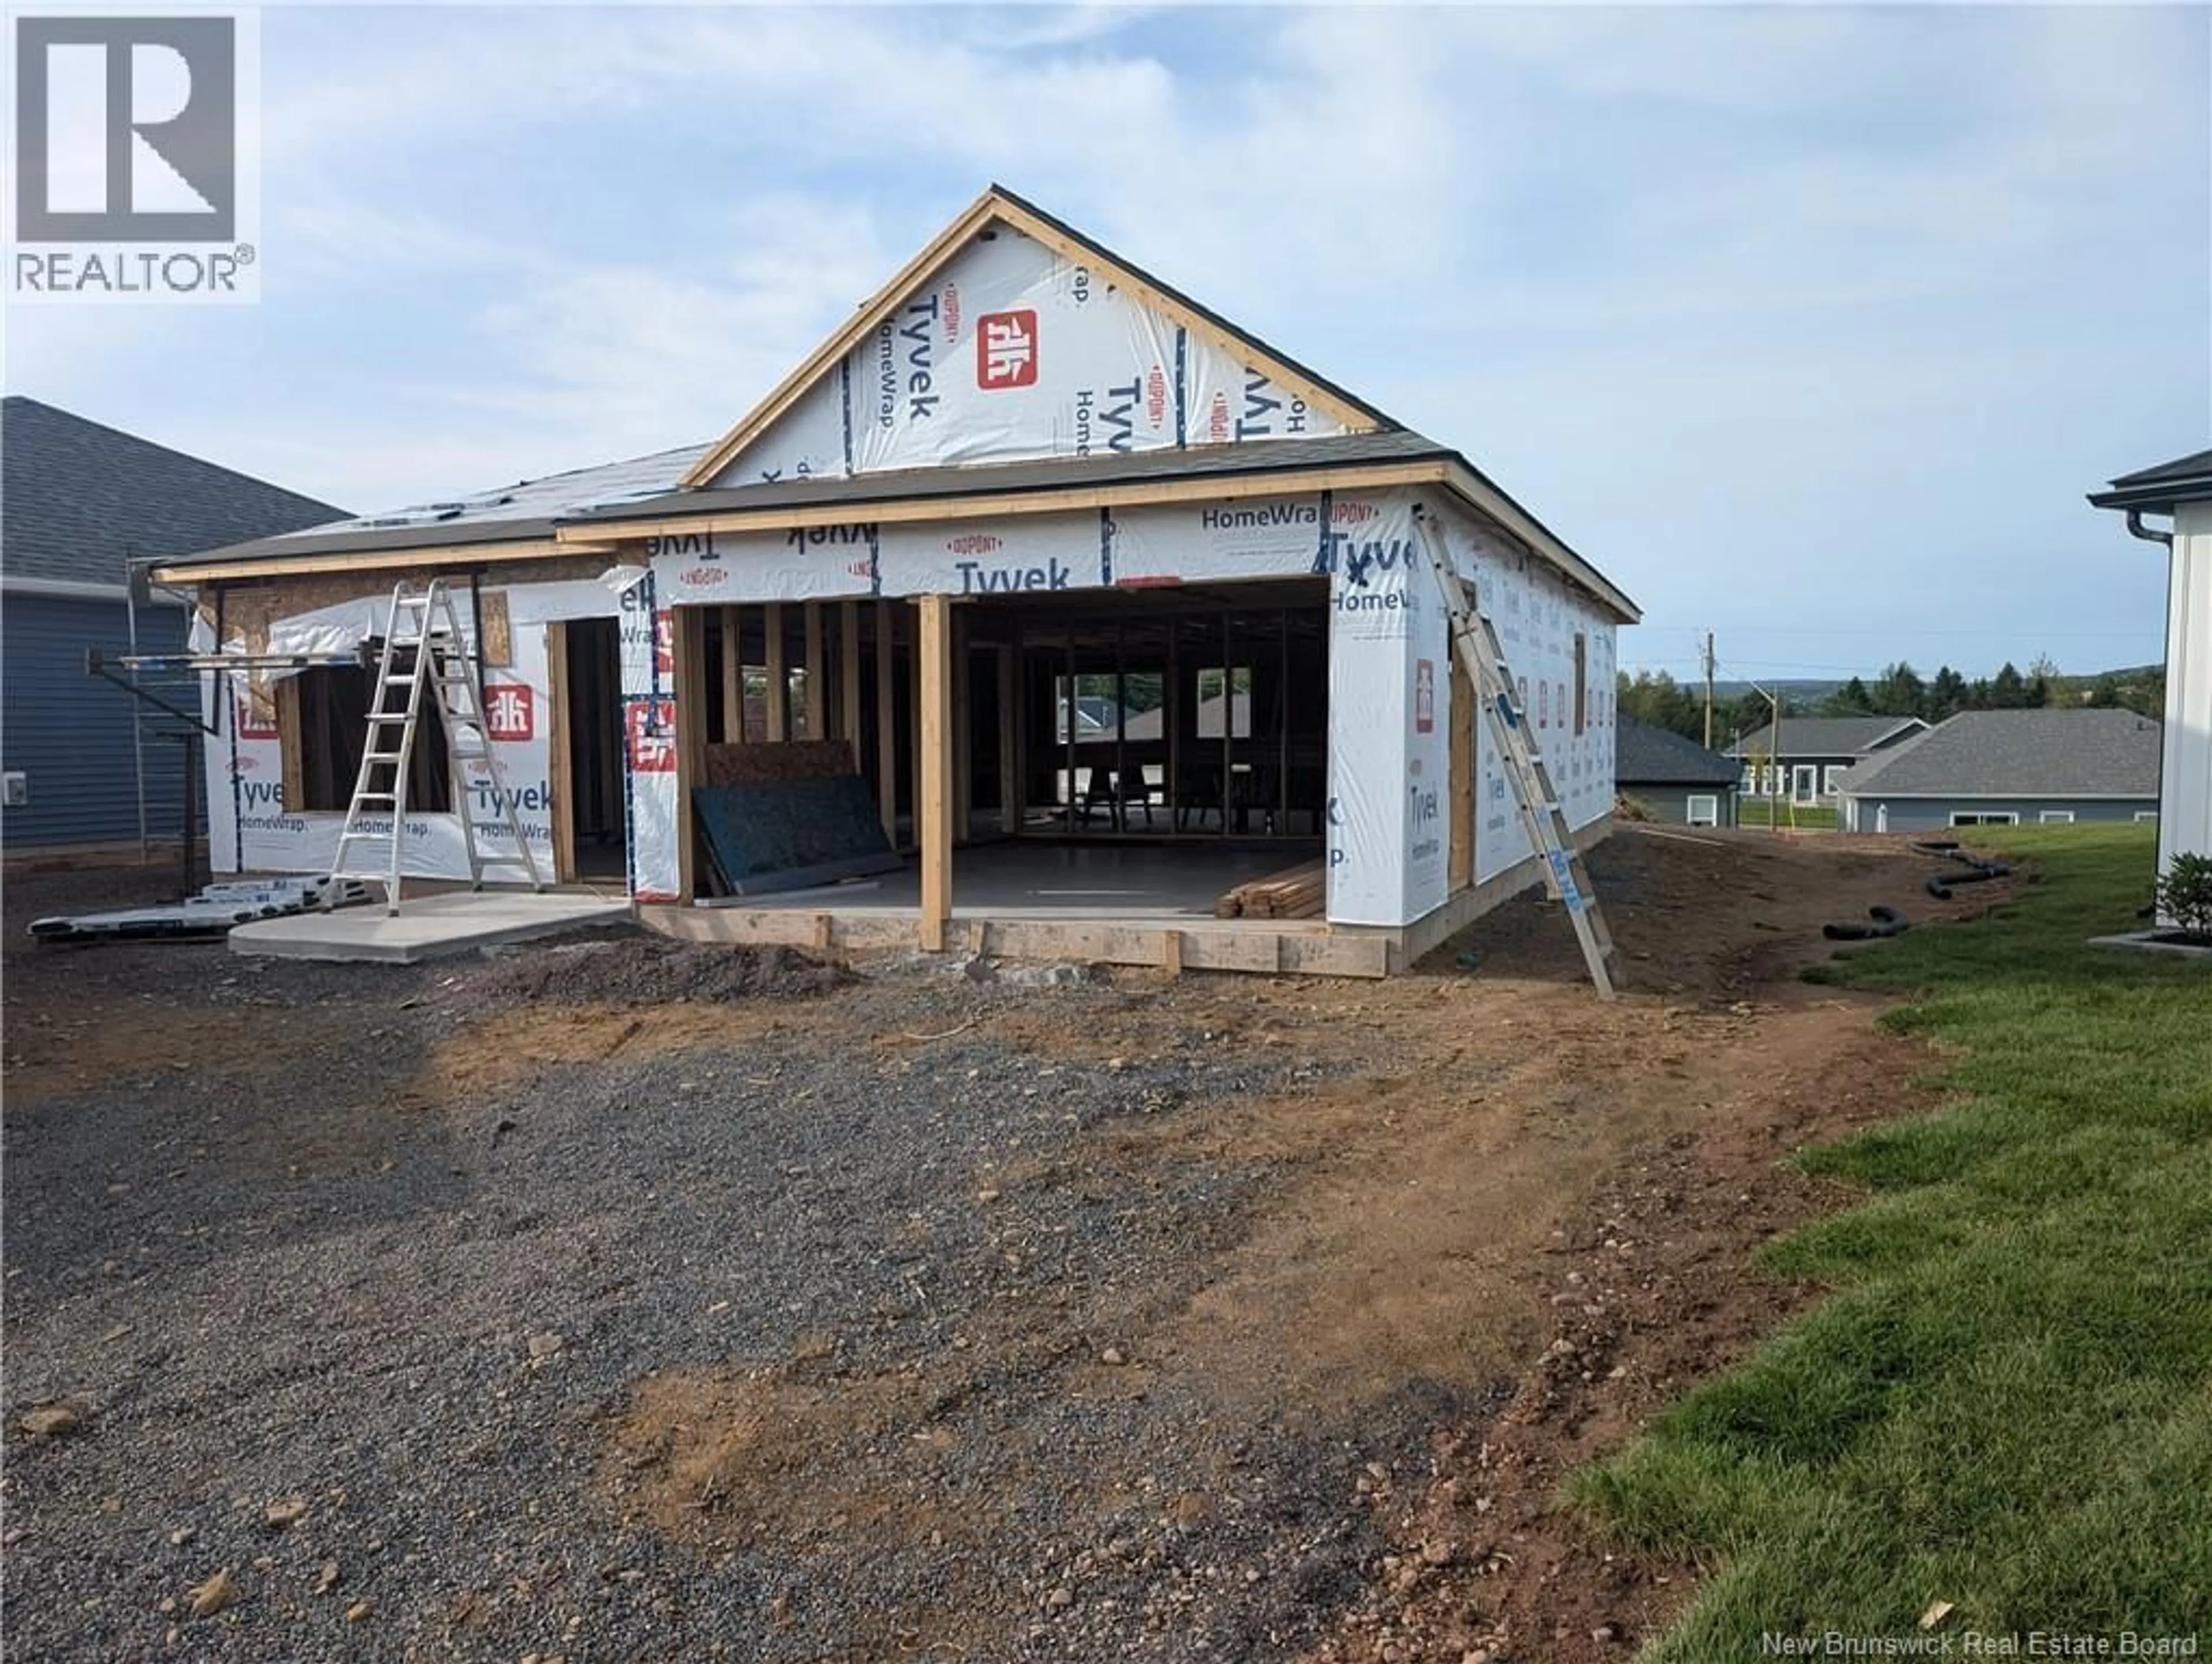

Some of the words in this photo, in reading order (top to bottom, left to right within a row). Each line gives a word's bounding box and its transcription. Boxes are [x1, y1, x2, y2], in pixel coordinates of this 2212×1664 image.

[900, 294, 940, 421] Tyvek
[1287, 394, 1306, 433] Ho
[955, 557, 1070, 593] Tyvek
[474, 779, 552, 818] Tyvek
